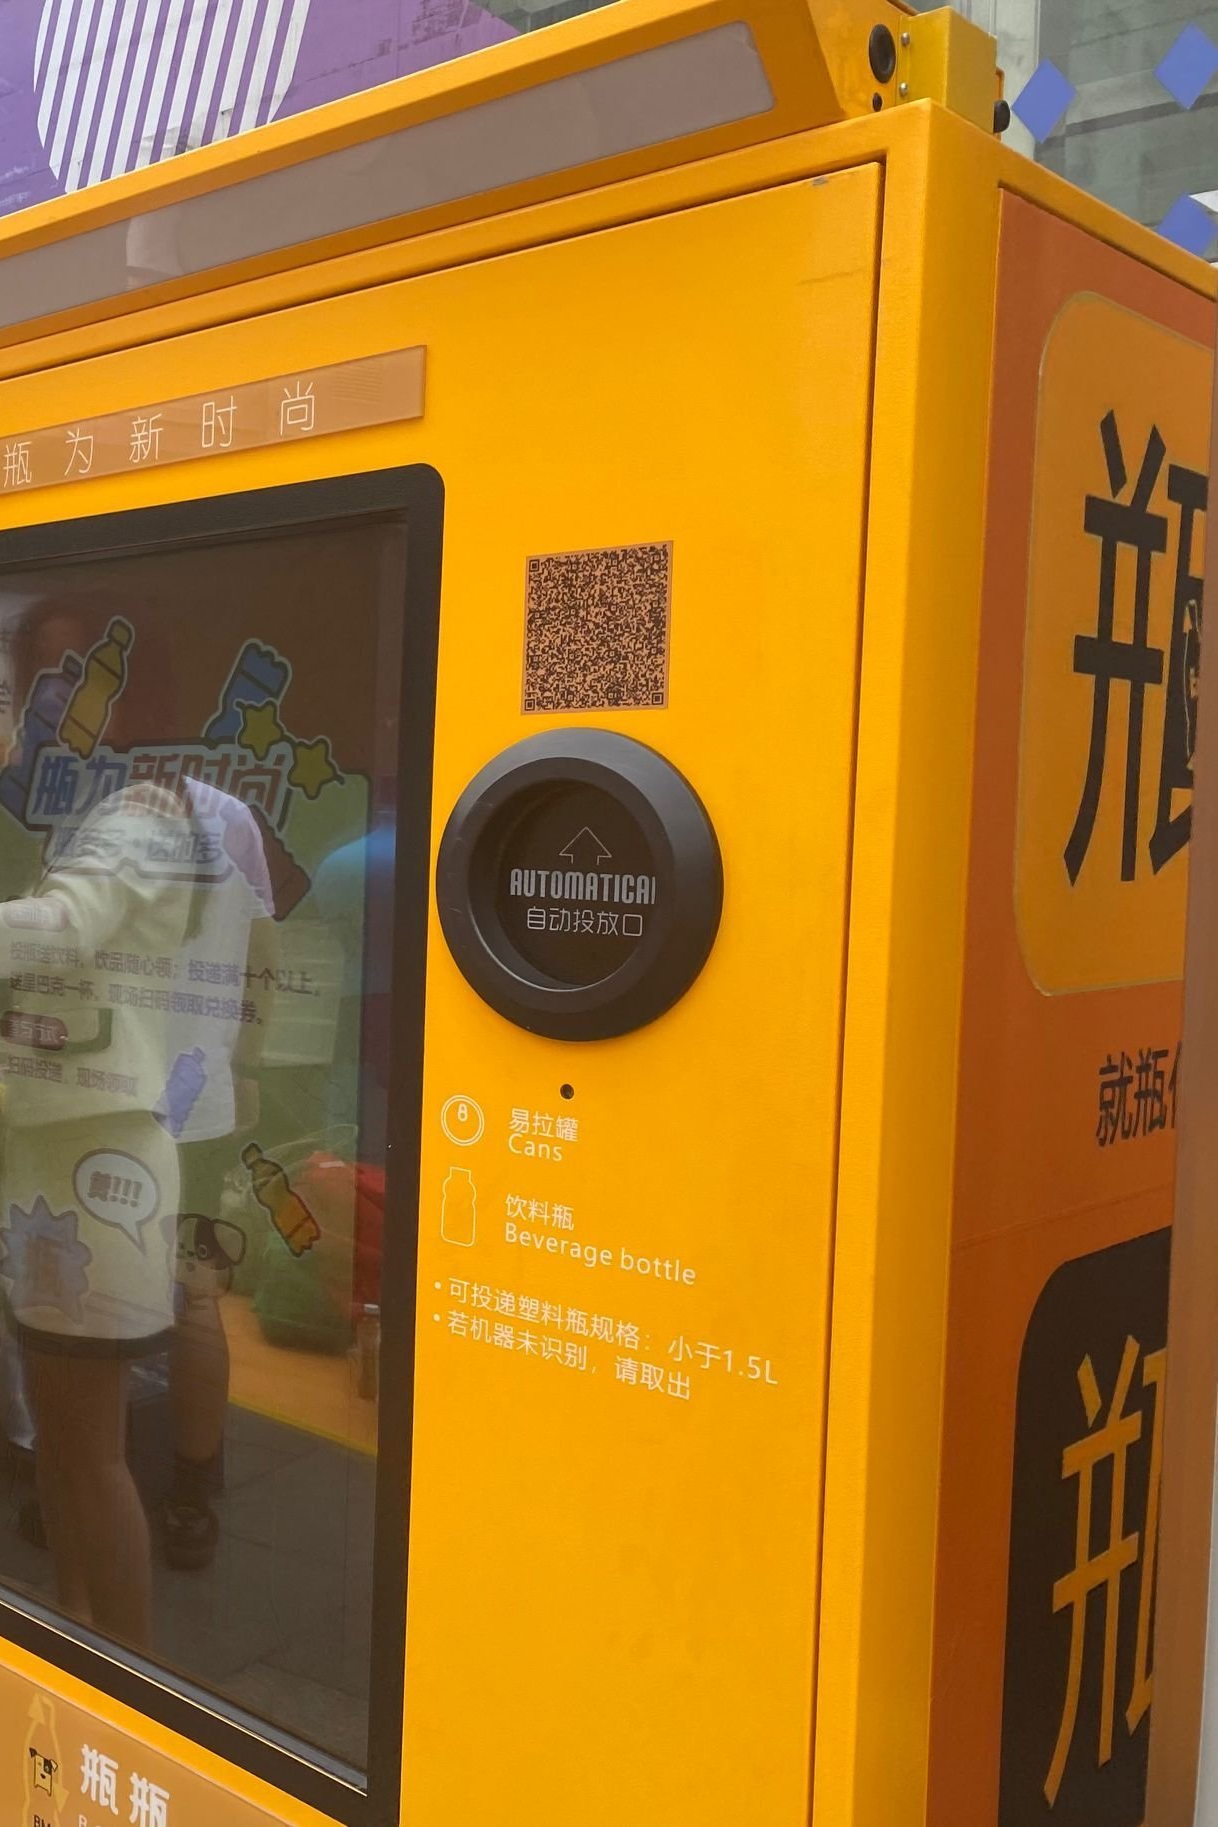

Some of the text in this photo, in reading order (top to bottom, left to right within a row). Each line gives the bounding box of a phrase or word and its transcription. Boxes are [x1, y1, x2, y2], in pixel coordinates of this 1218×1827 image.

[3, 381, 315, 488] 瓶为新时尚
[527, 906, 643, 937] 自动投放口
[509, 1107, 579, 1143] 易拉罐
[508, 1133, 563, 1162] Cans
[505, 1194, 575, 1231] 饮料瓶
[505, 1223, 697, 1285] Beverage bottle
